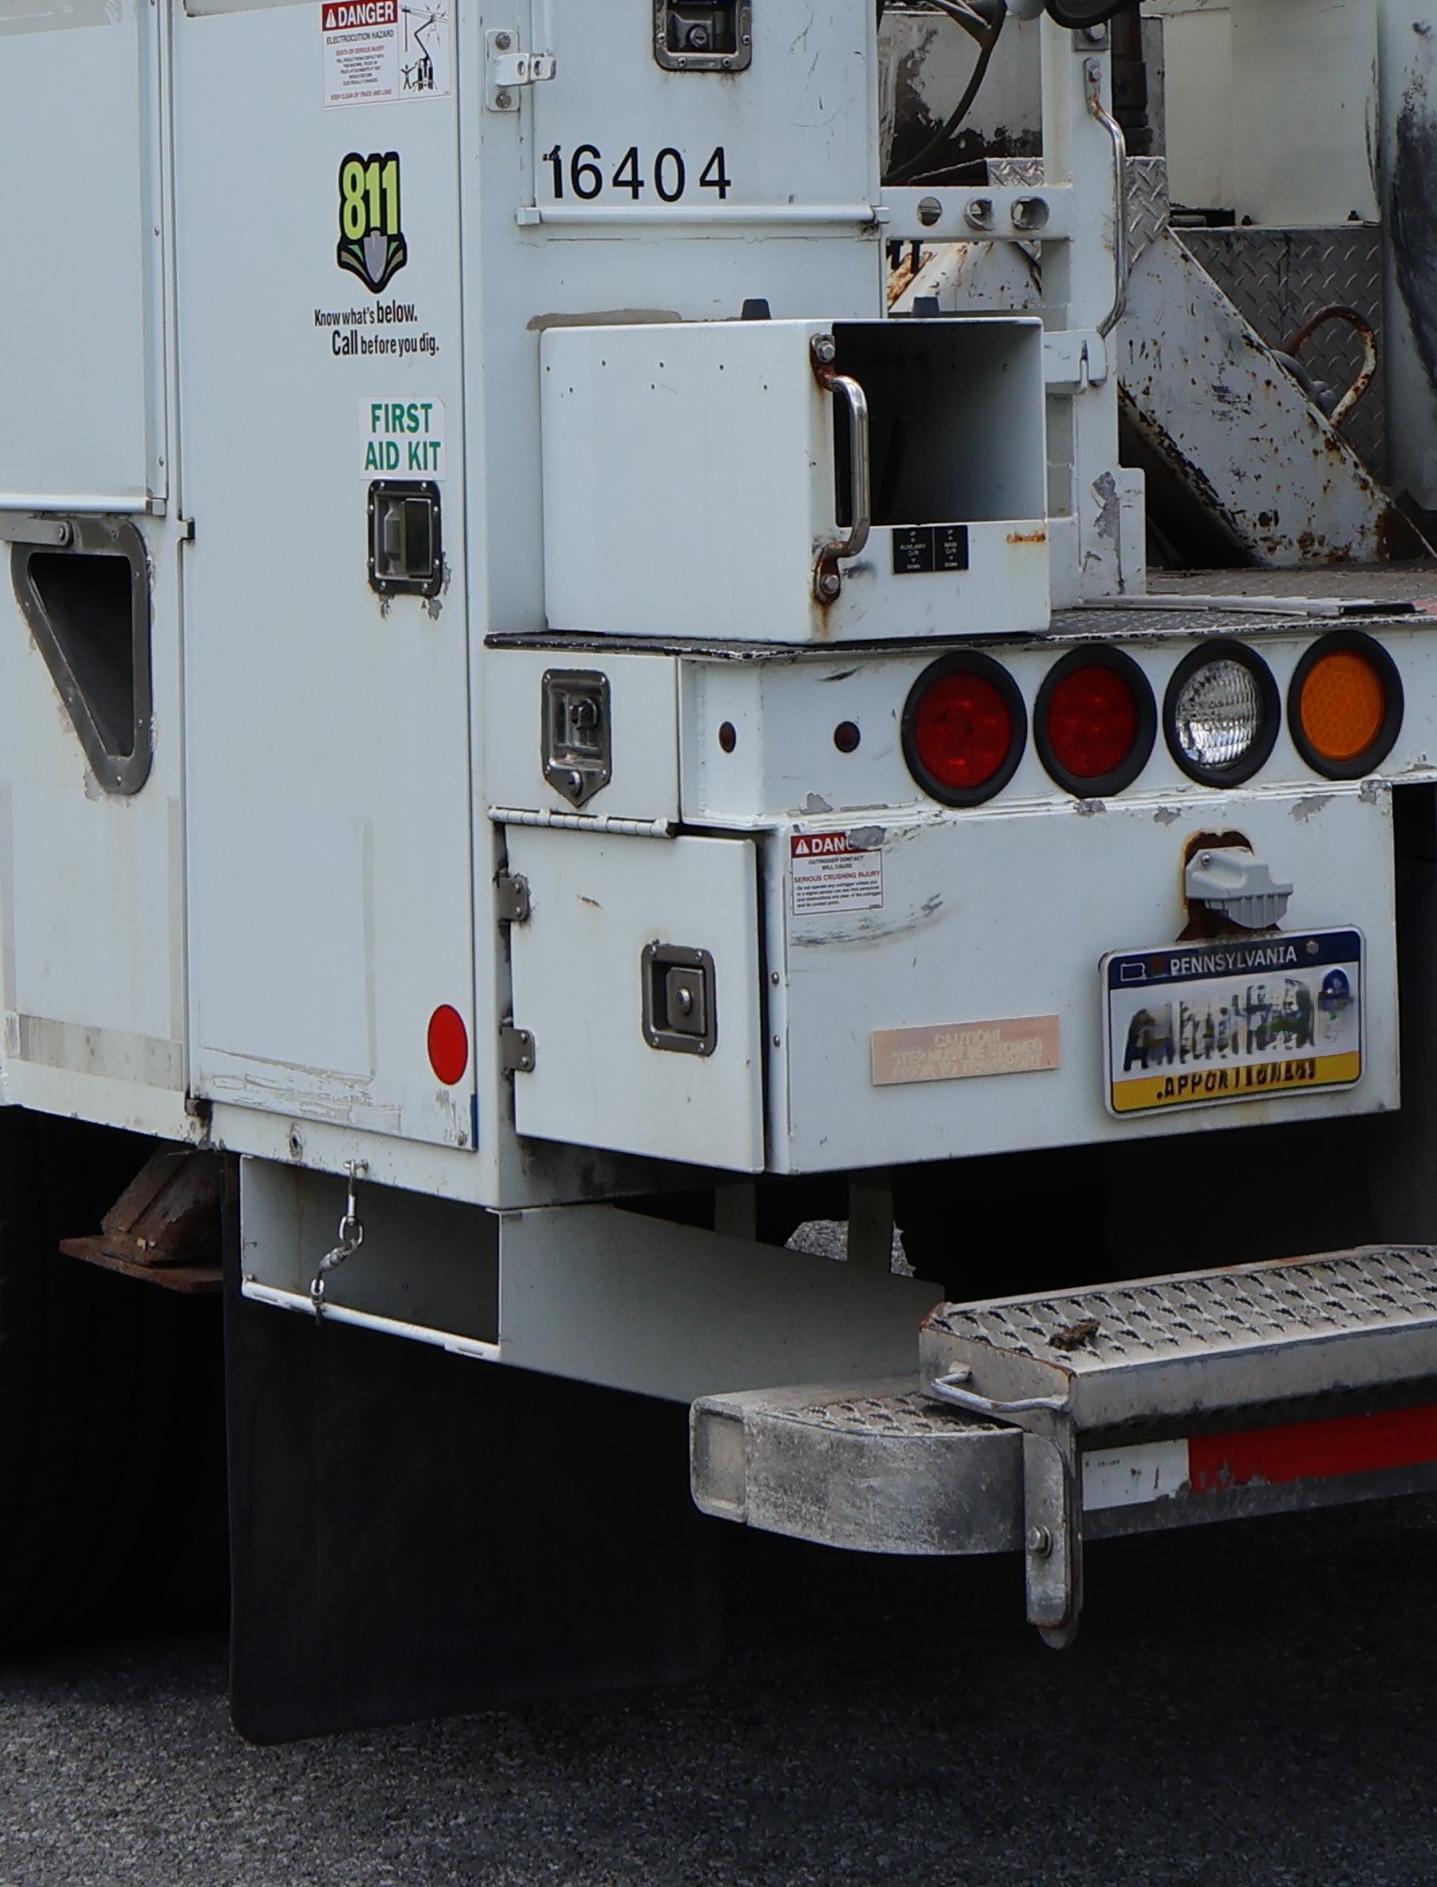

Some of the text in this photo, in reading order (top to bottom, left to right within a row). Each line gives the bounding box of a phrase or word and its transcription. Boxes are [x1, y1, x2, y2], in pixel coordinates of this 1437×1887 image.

[338, 0, 395, 27] DANGER
[326, 29, 394, 44] ELECTROCUTION HAZARD
[542, 144, 732, 203] 16404
[342, 160, 398, 241] 811
[314, 300, 418, 327] Know what's below.
[332, 330, 439, 357] Call before you dig.
[371, 402, 433, 433] FIRST
[364, 440, 441, 471] AID KIT
[1170, 946, 1298, 976] PENNSYLVANIA
